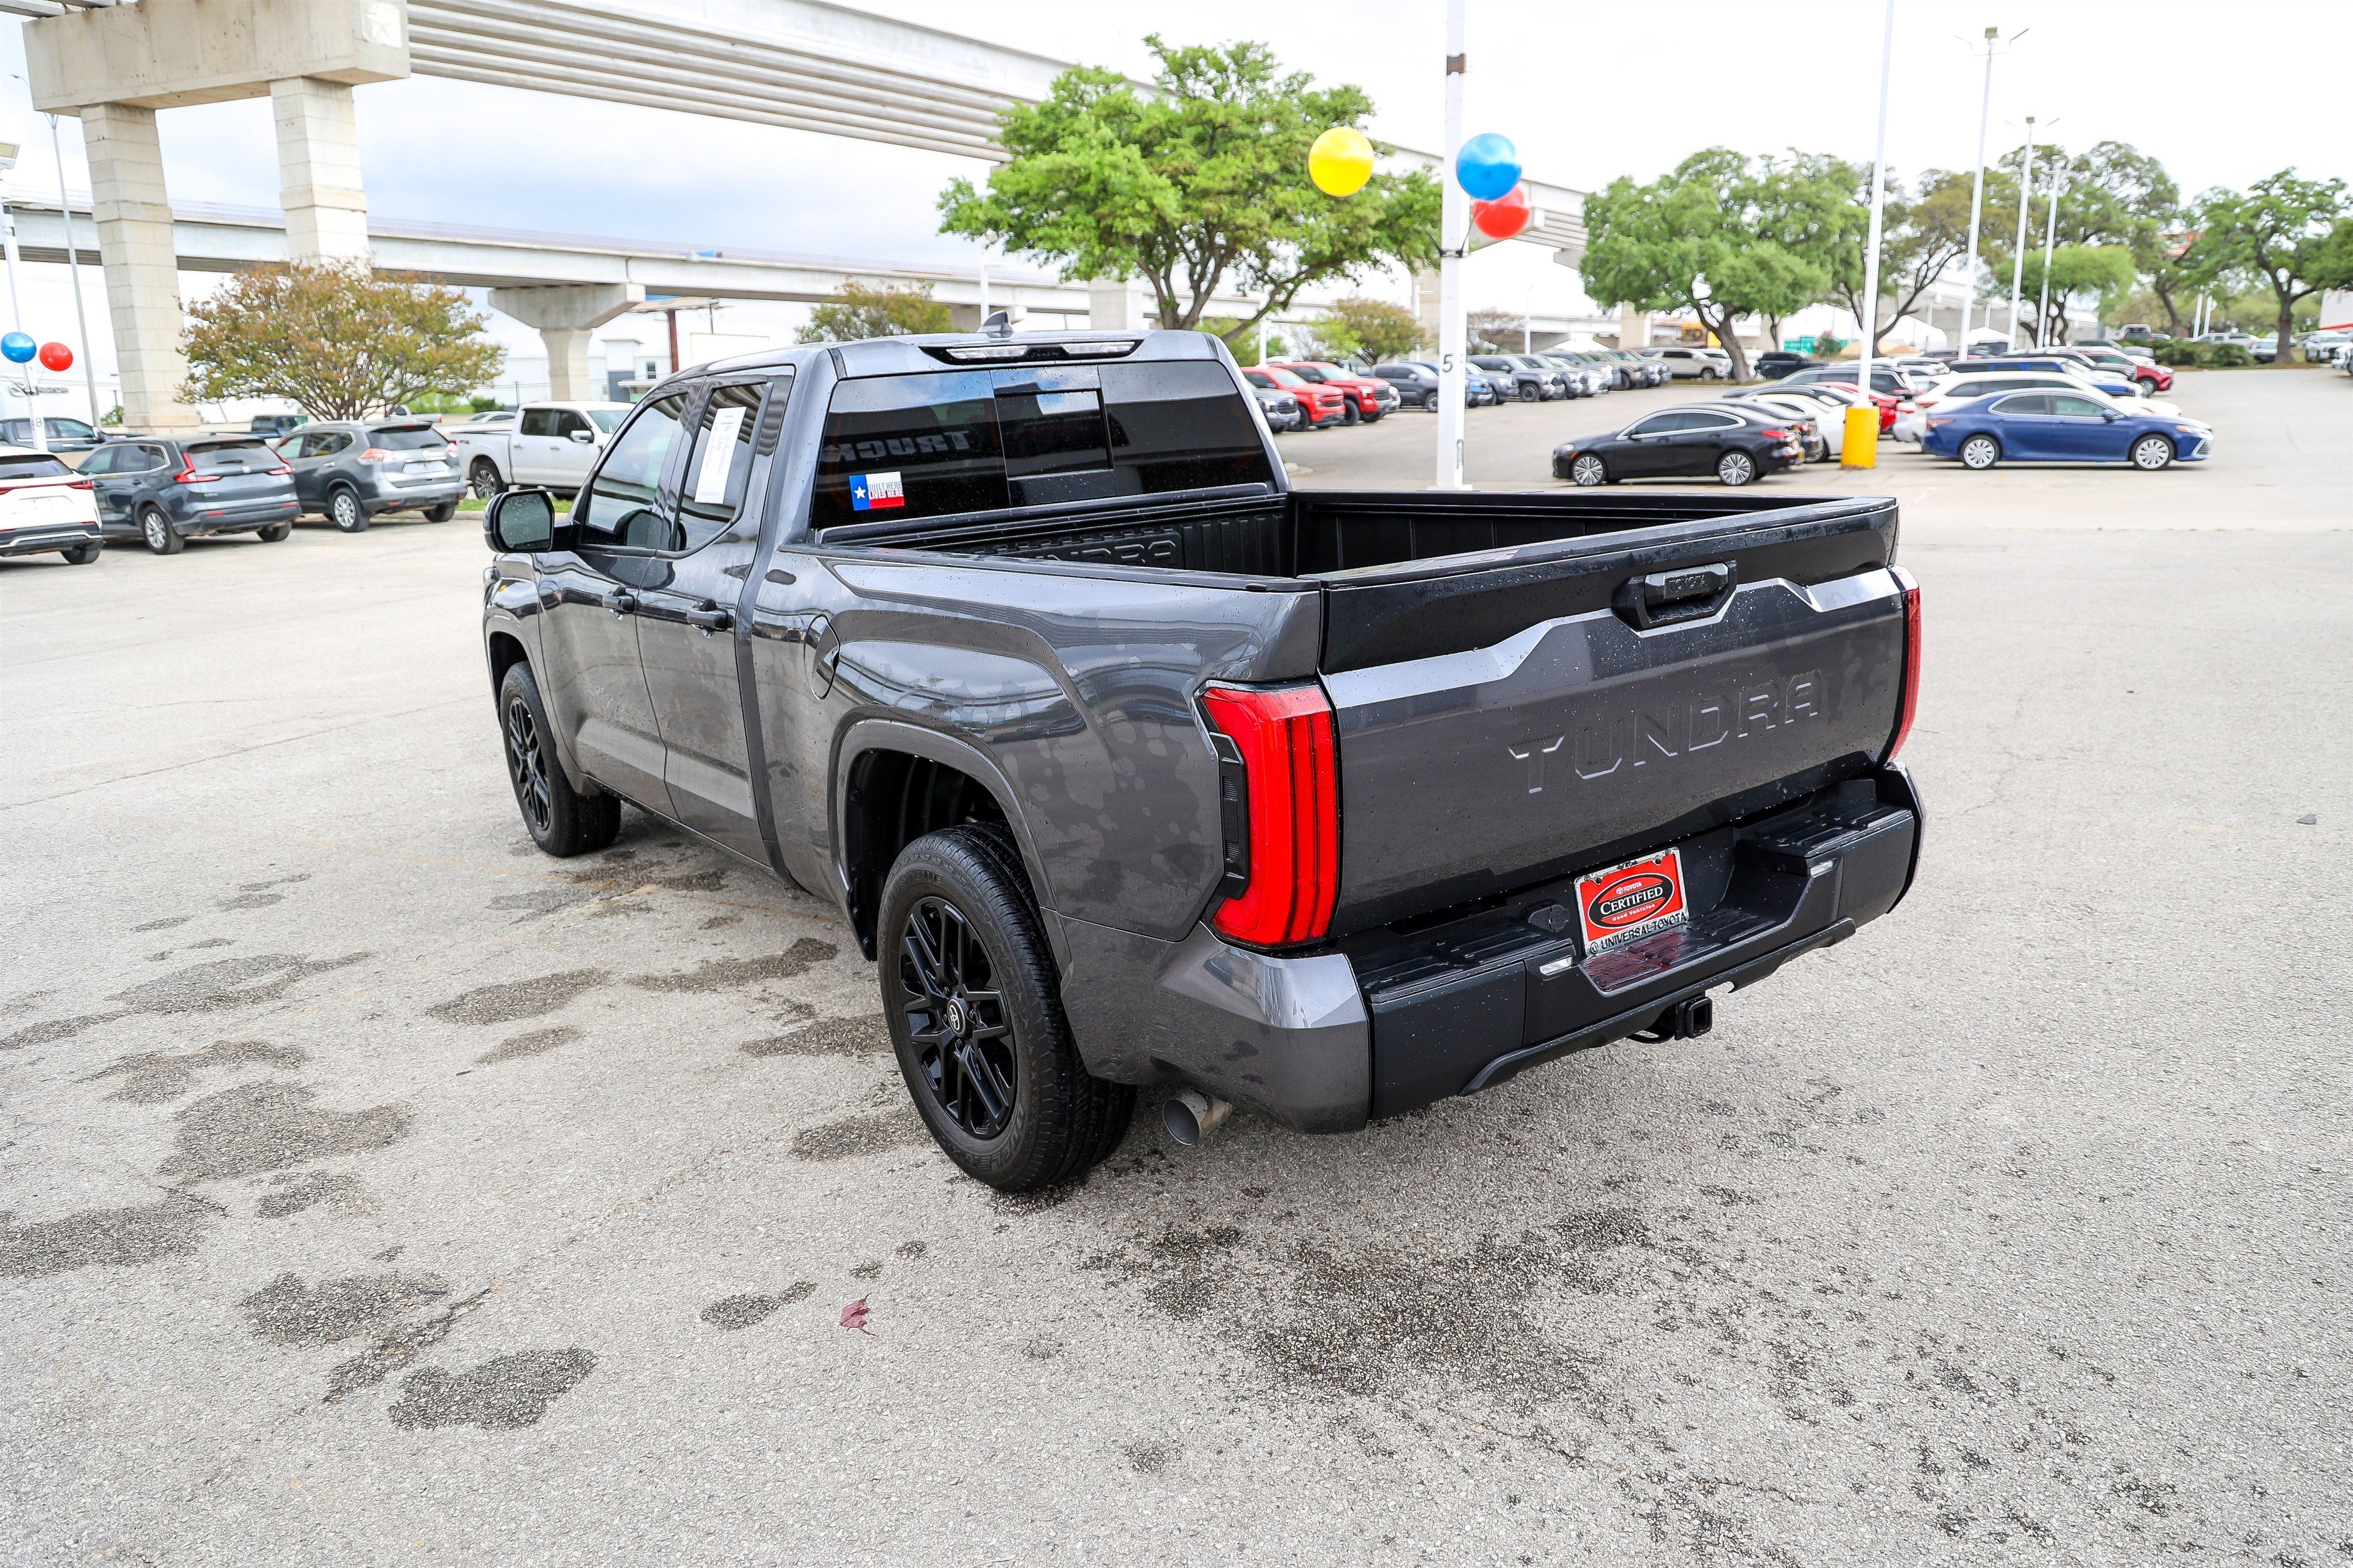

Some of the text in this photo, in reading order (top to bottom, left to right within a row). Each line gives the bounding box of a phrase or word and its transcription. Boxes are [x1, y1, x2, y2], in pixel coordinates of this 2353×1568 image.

[1442, 353, 1453, 373] 5
[35, 417, 43, 427] 8
[868, 481, 902, 492] BUILT HERE
[868, 488, 904, 500] LIVES HERE
[1668, 574, 1708, 593] TOYOTA
[1508, 668, 1824, 794] TUNDRA
[1623, 881, 1643, 892] TOYOTA
[1600, 886, 1663, 915] CERTIFIED
[1612, 903, 1656, 921] Used Vehicles
[1600, 924, 1653, 949] UNIVERSAL
[1652, 912, 1687, 931] TOYOTA
